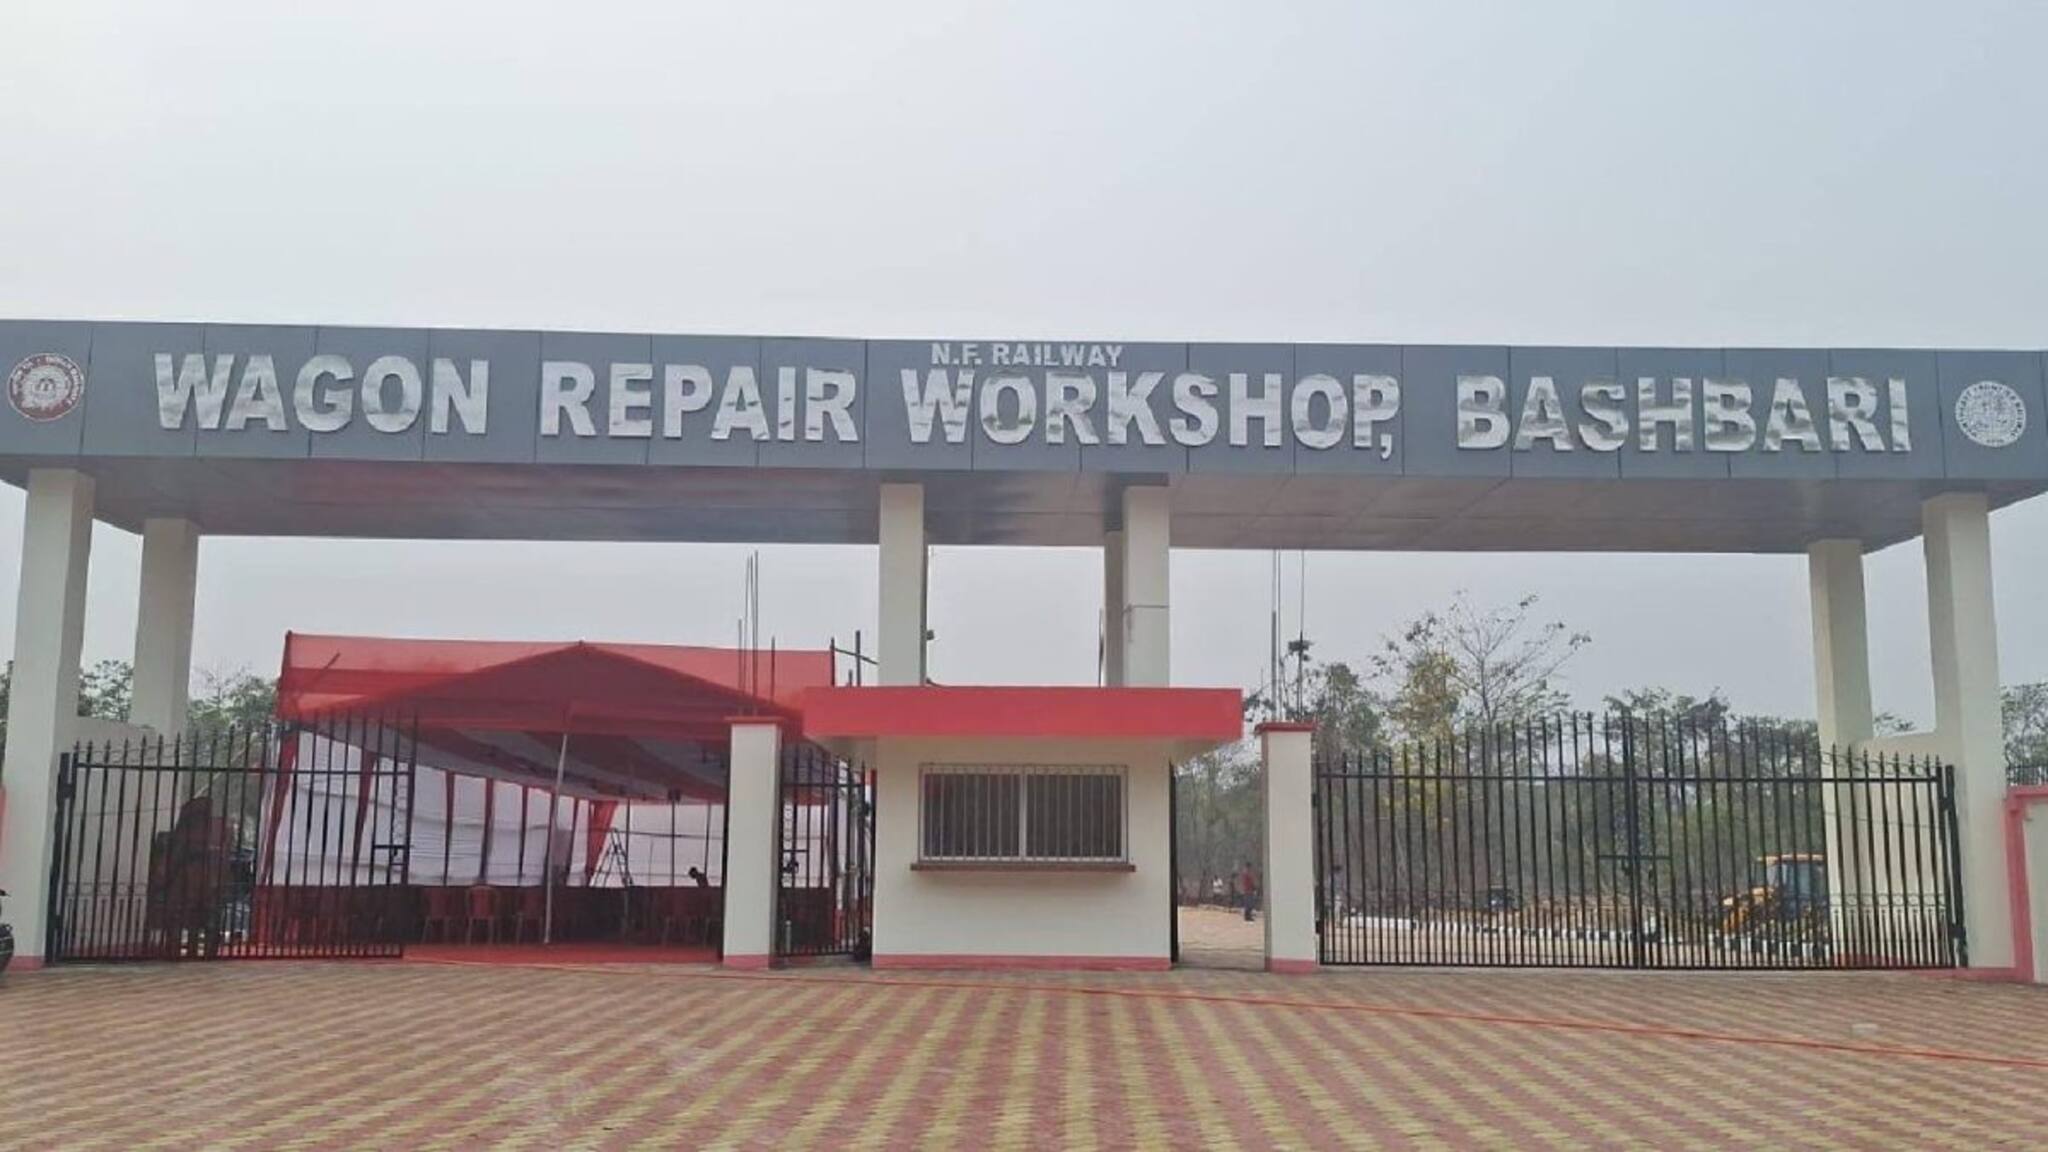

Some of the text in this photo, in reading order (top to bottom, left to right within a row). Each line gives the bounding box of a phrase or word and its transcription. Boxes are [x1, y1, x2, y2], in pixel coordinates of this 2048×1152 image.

[931, 343, 1124, 367] N.F. RAILWAY
[153, 353, 490, 434] WAGON
[540, 360, 859, 442] REPAIR
[900, 367, 1400, 460] WORKSHOP,
[1456, 375, 1912, 453] BASHBARI
